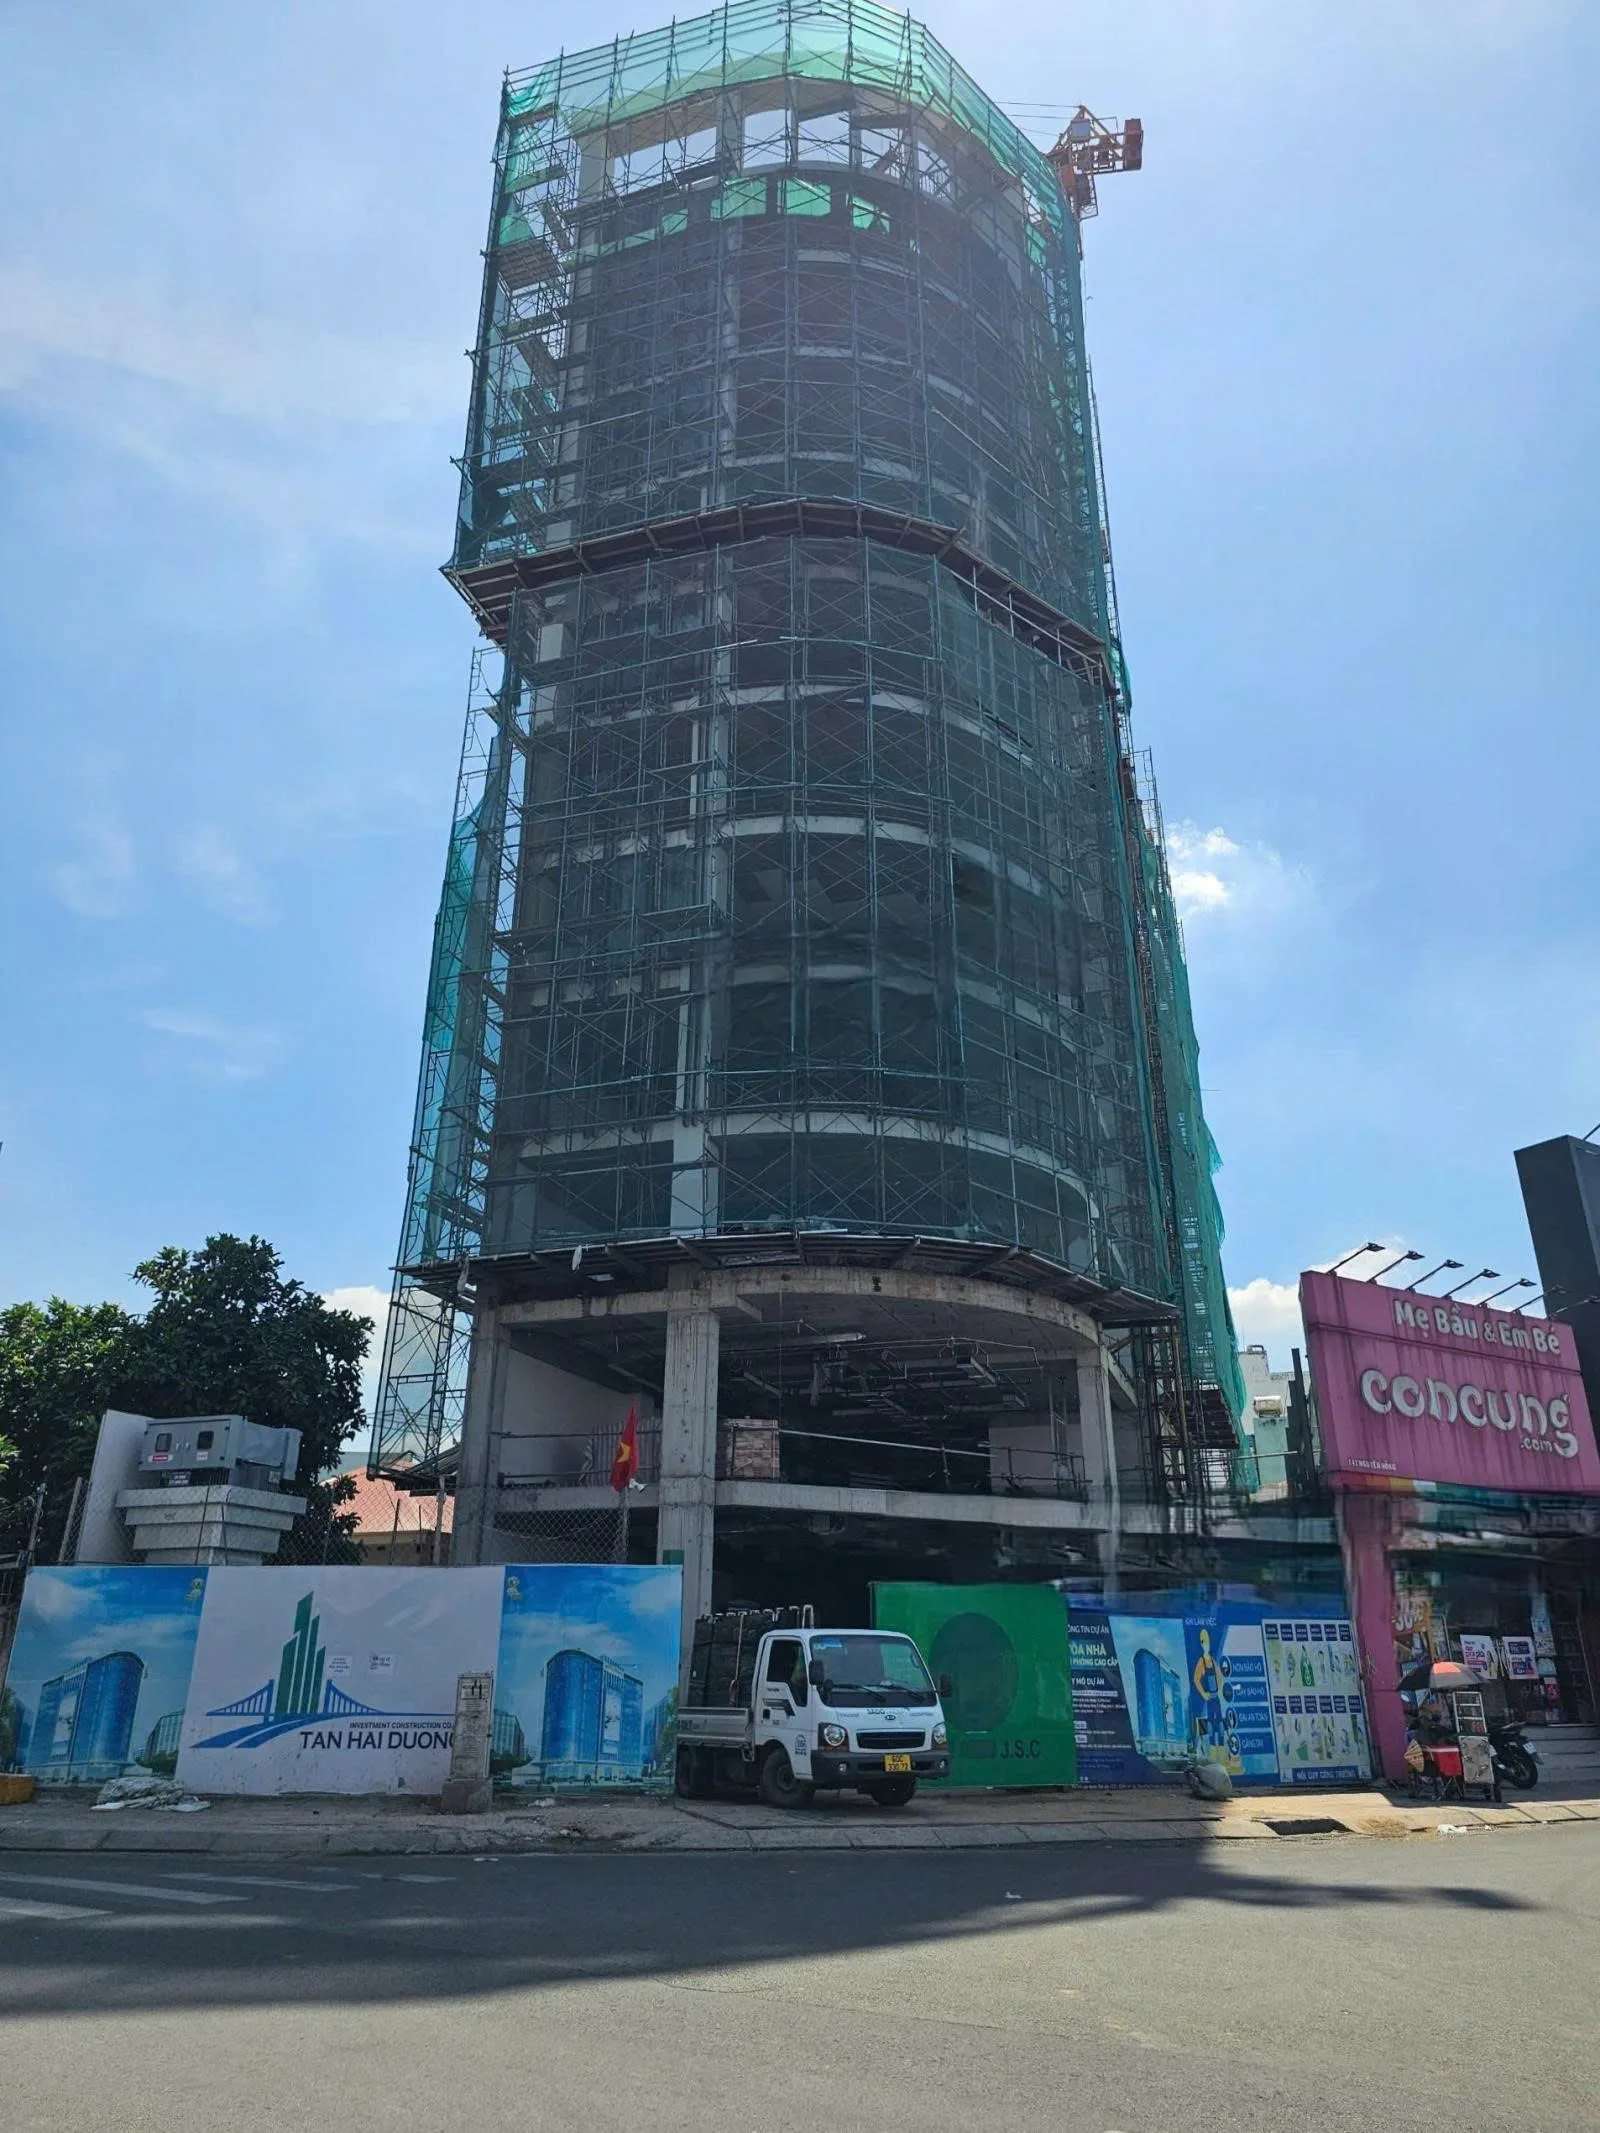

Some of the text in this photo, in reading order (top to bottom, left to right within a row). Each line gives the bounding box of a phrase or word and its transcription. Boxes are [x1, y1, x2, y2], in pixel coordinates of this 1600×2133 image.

[1394, 1300, 1561, 1354] Mẹ Bầu & Em Bé
[1086, 1642, 1106, 1656] NHÀ
[1094, 1658, 1106, 1666] CAO
[349, 1722, 391, 1730] INVESTMENT
[300, 1731, 342, 1749] TAN
[347, 1731, 383, 1749] HAI
